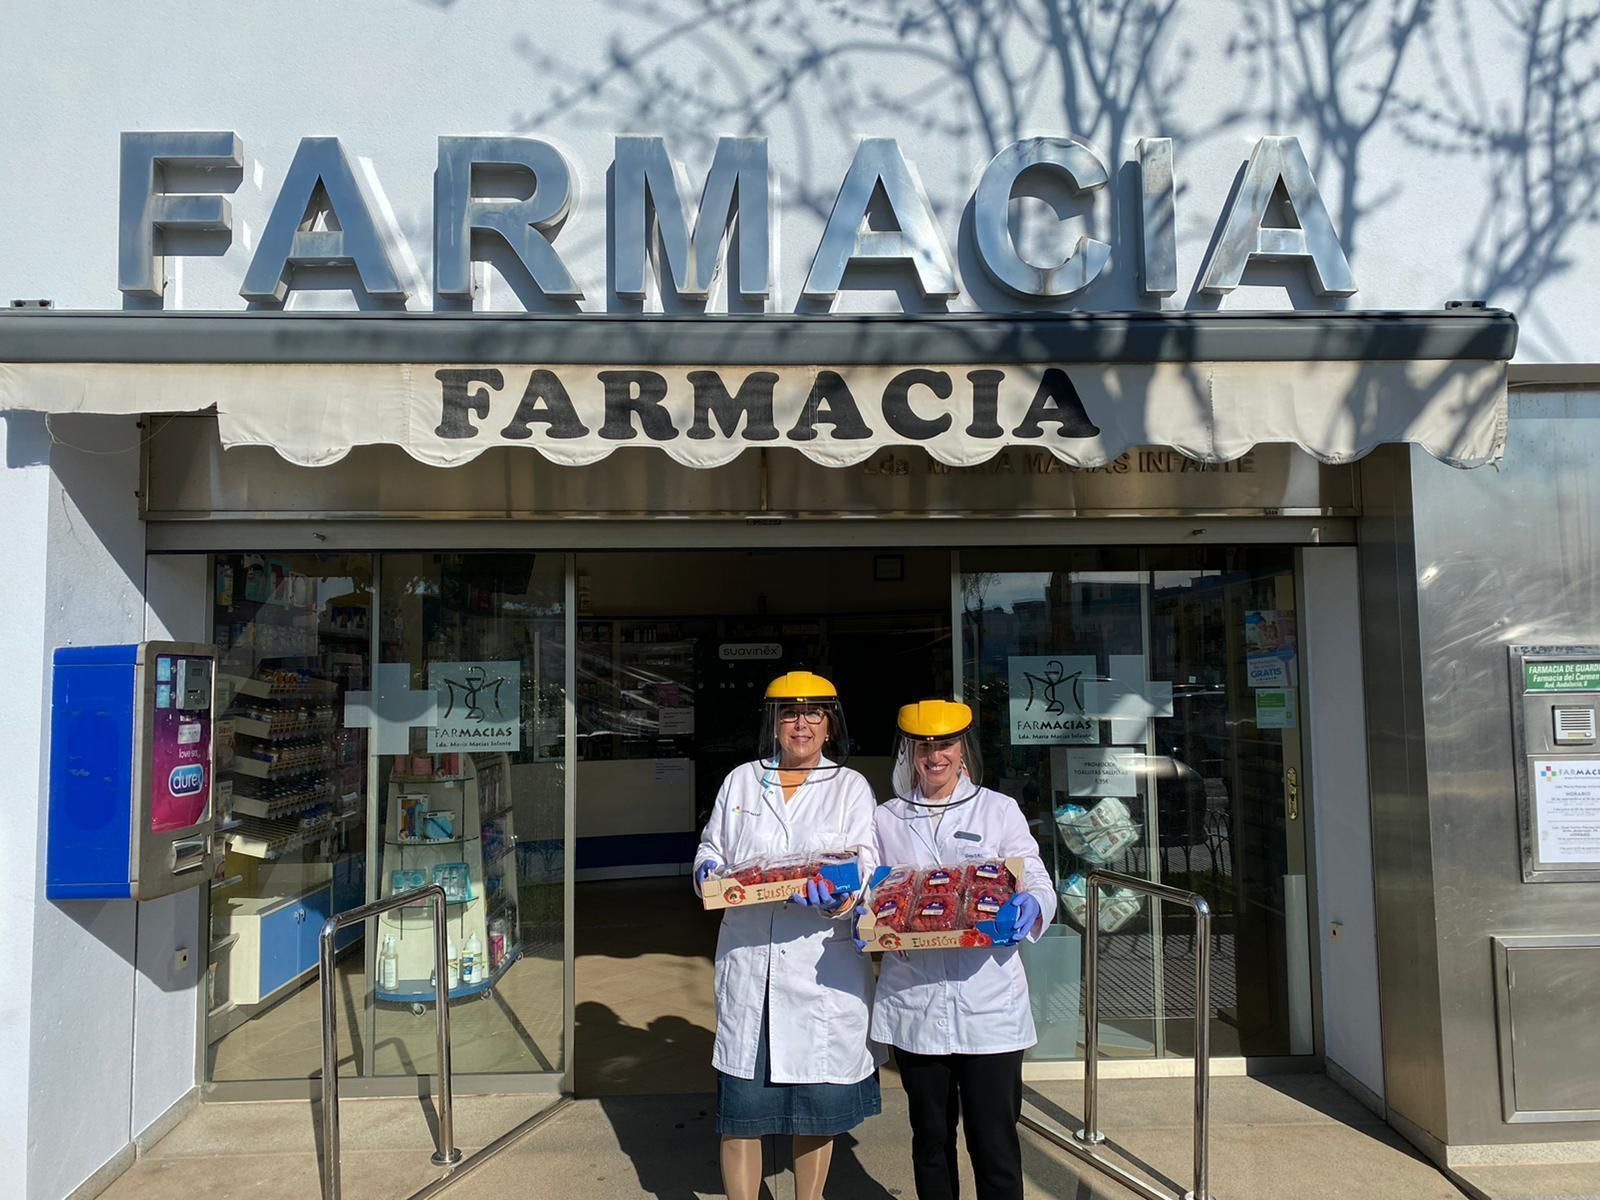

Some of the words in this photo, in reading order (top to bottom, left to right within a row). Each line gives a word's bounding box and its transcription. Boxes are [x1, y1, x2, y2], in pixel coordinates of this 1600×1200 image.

[118, 131, 1358, 302] FARMACIA
[434, 367, 1100, 440] FARMACIA
[1250, 667, 1282, 678] GRATIS
[1528, 665, 1564, 674] FARMACIA
[1565, 664, 1574, 673] DE
[1017, 720, 1092, 730] FARMACIAS
[435, 727, 512, 738] FARMACIAS
